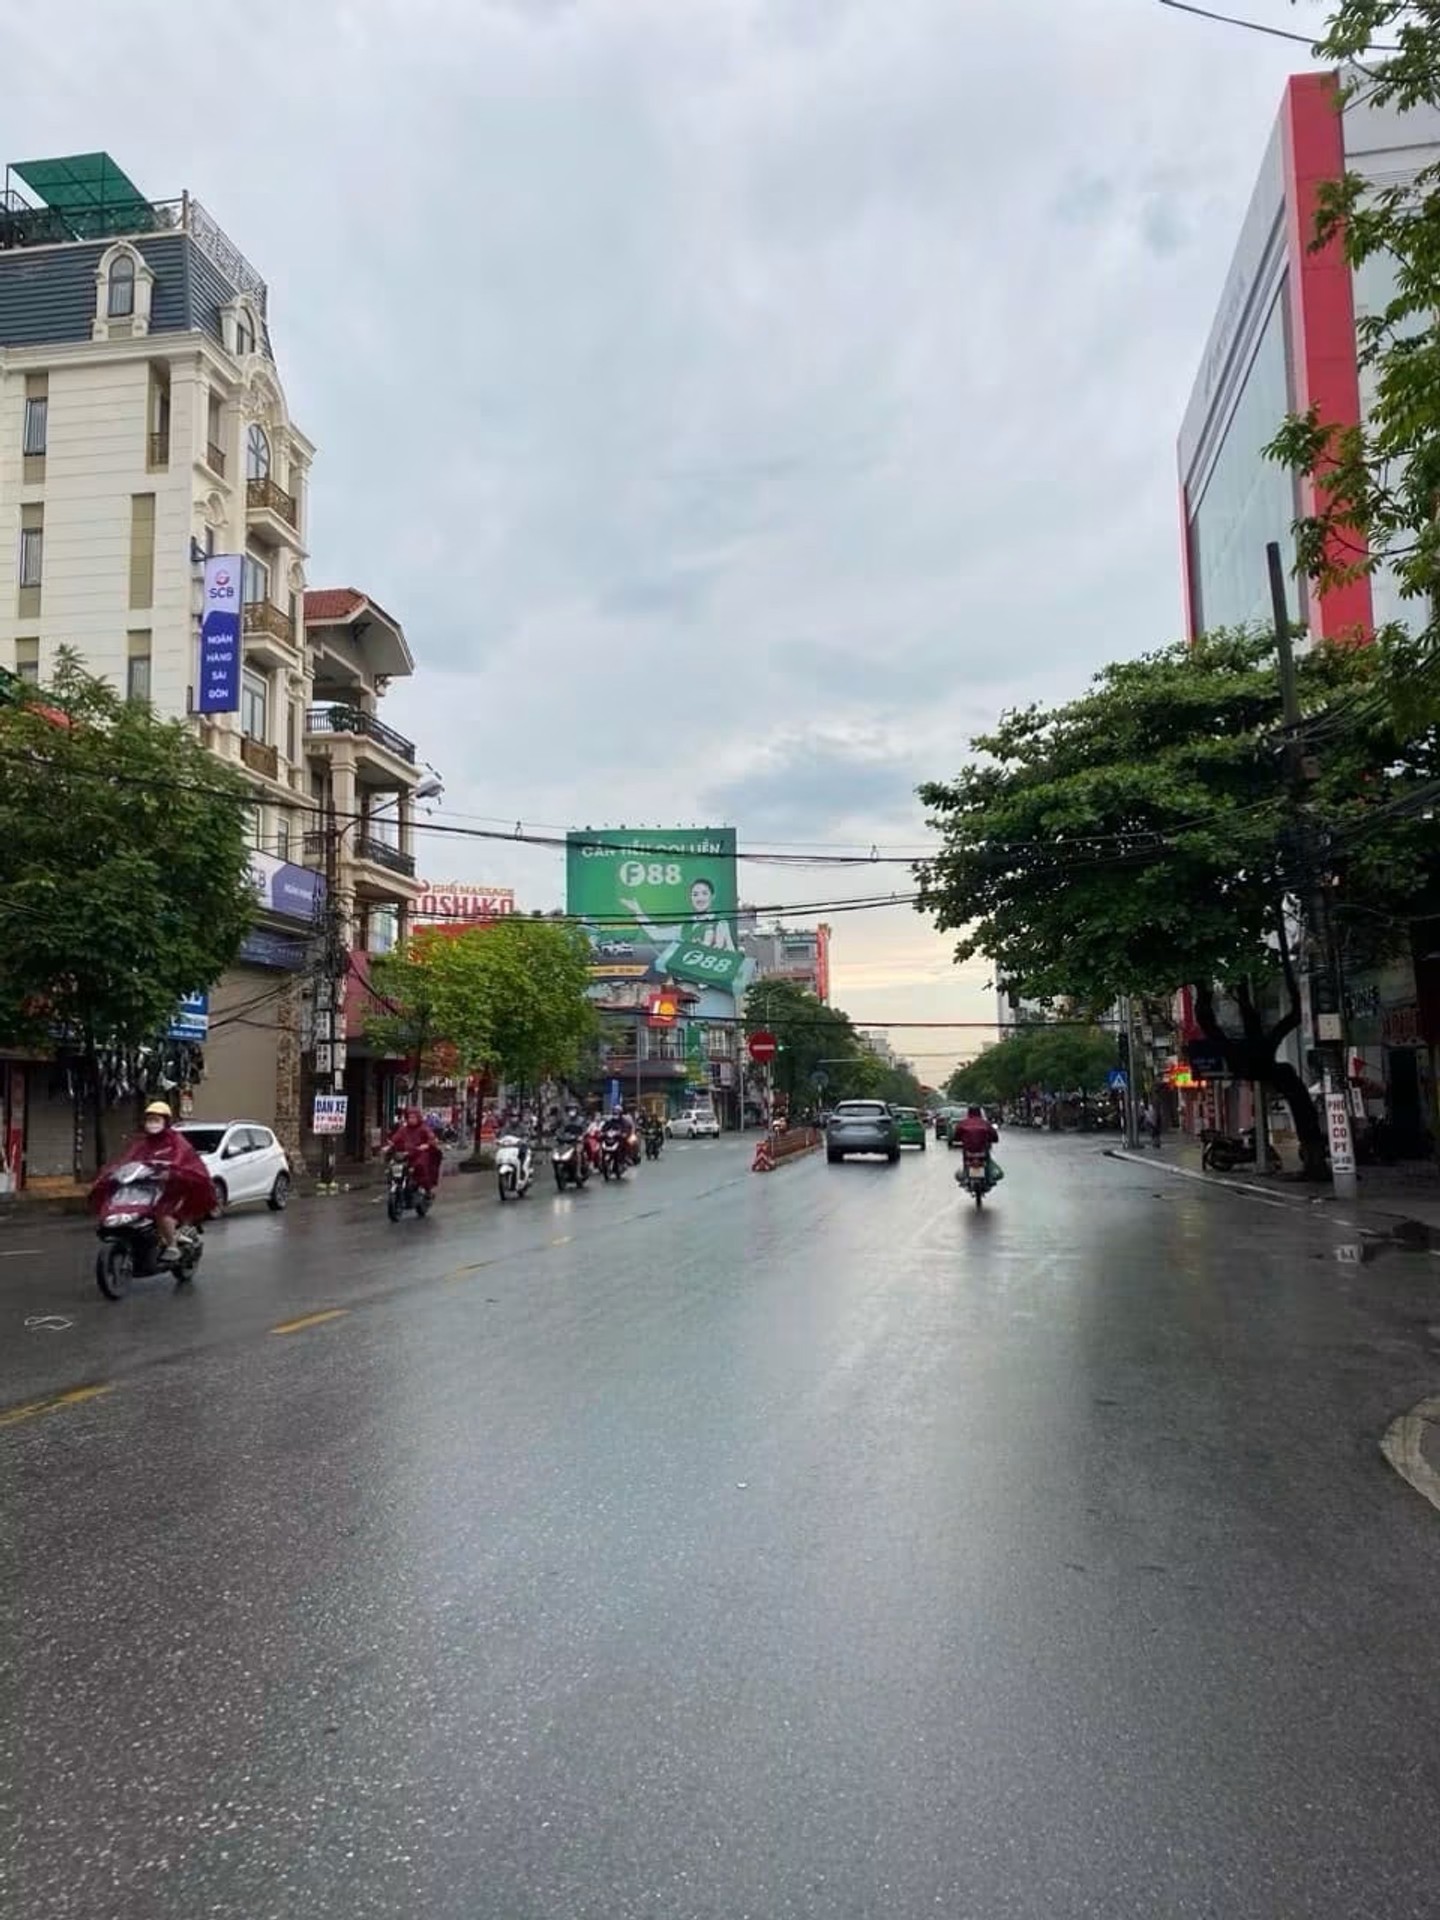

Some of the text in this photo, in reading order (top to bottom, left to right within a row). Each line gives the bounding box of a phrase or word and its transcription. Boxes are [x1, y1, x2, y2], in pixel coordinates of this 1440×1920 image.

[208, 587, 235, 599] SCB
[619, 860, 682, 887] F88
[459, 884, 515, 897] MASSAGE
[682, 949, 733, 974] F88
[1332, 1114, 1345, 1125] TO
[1333, 1127, 1347, 1139] CO
